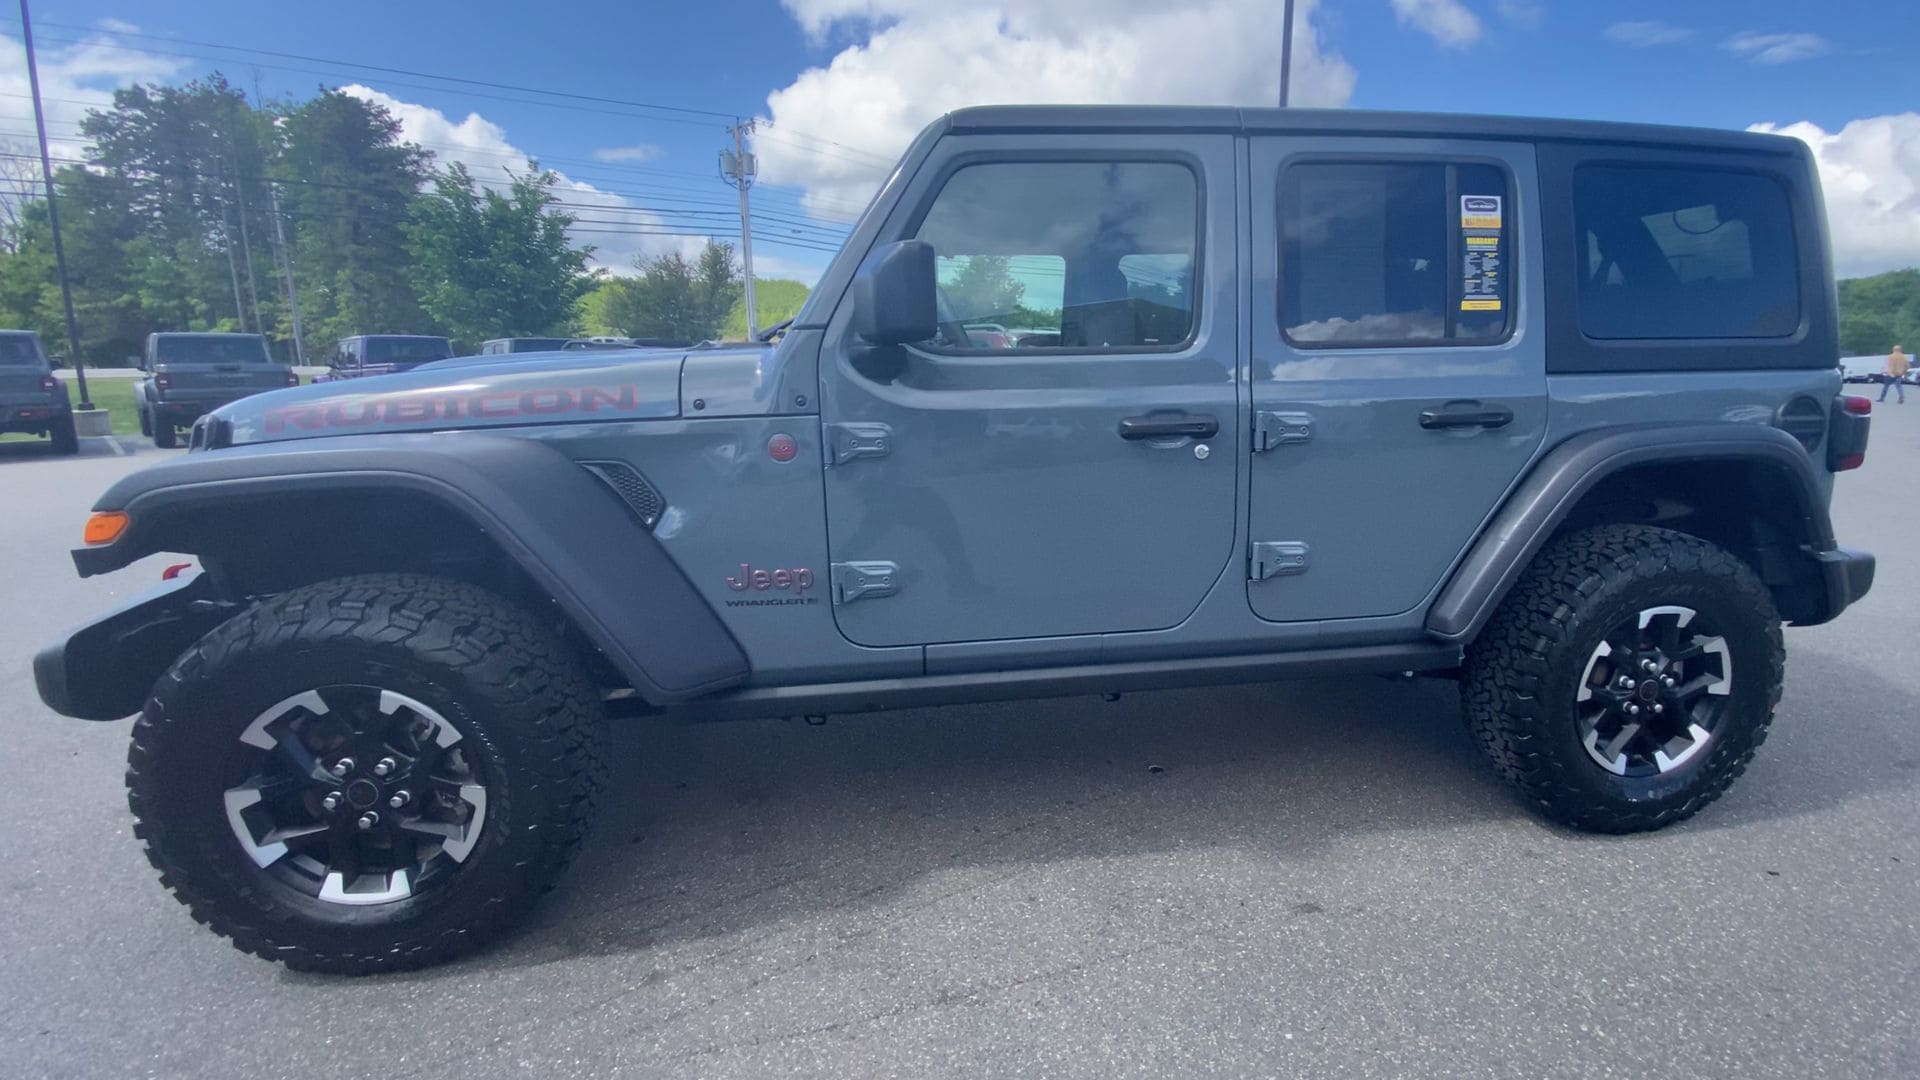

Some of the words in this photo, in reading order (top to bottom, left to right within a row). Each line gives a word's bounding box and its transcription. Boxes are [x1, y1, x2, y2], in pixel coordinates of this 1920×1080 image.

[265, 384, 638, 434] RUBICON
[727, 563, 814, 594] Jeep
[725, 598, 805, 608] WRANGLER
